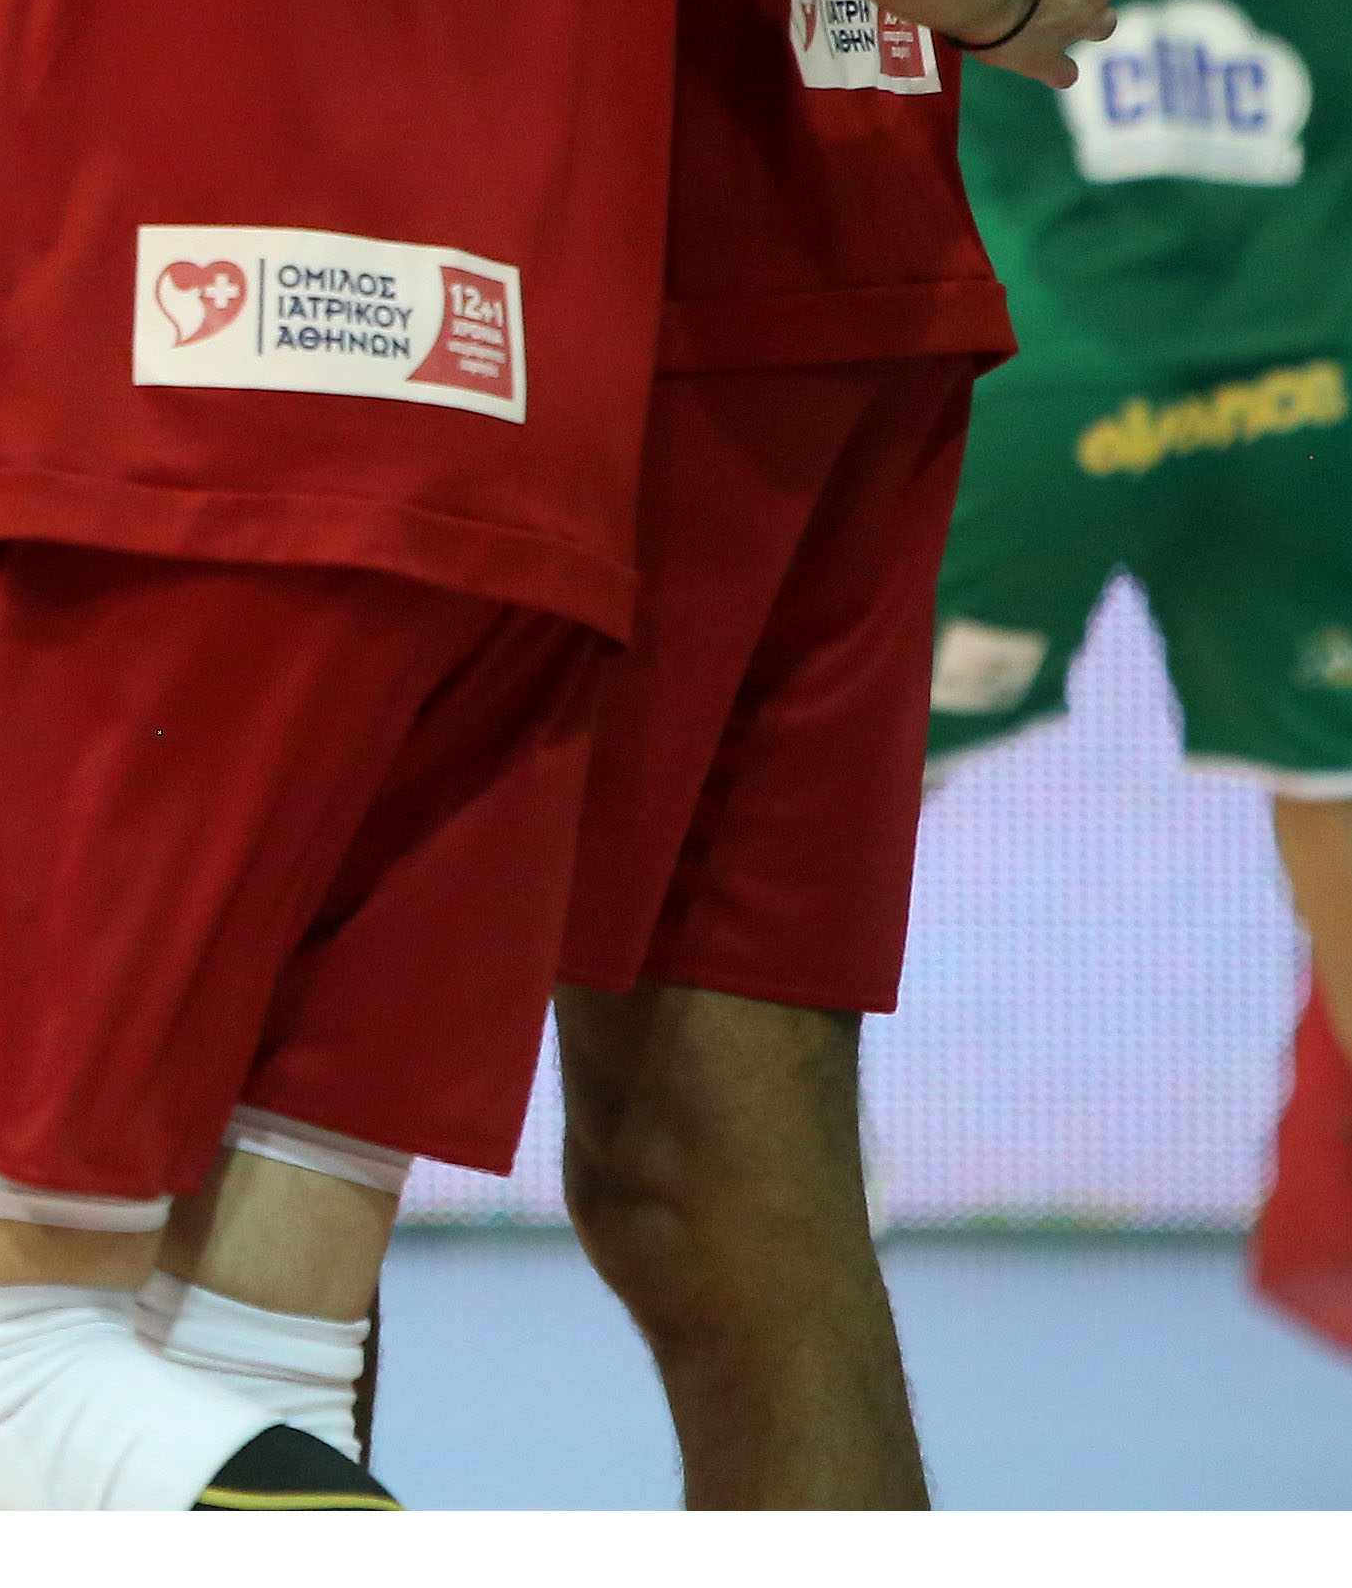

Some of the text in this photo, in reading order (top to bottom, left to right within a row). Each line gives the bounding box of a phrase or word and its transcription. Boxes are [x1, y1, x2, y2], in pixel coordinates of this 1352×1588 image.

[278, 264, 396, 299] ΟΜΙΛΟΣ
[278, 295, 414, 331] ΙΑΤΡΙΚΟΥ
[275, 325, 411, 360] ΑΘΗΝΩΝ
